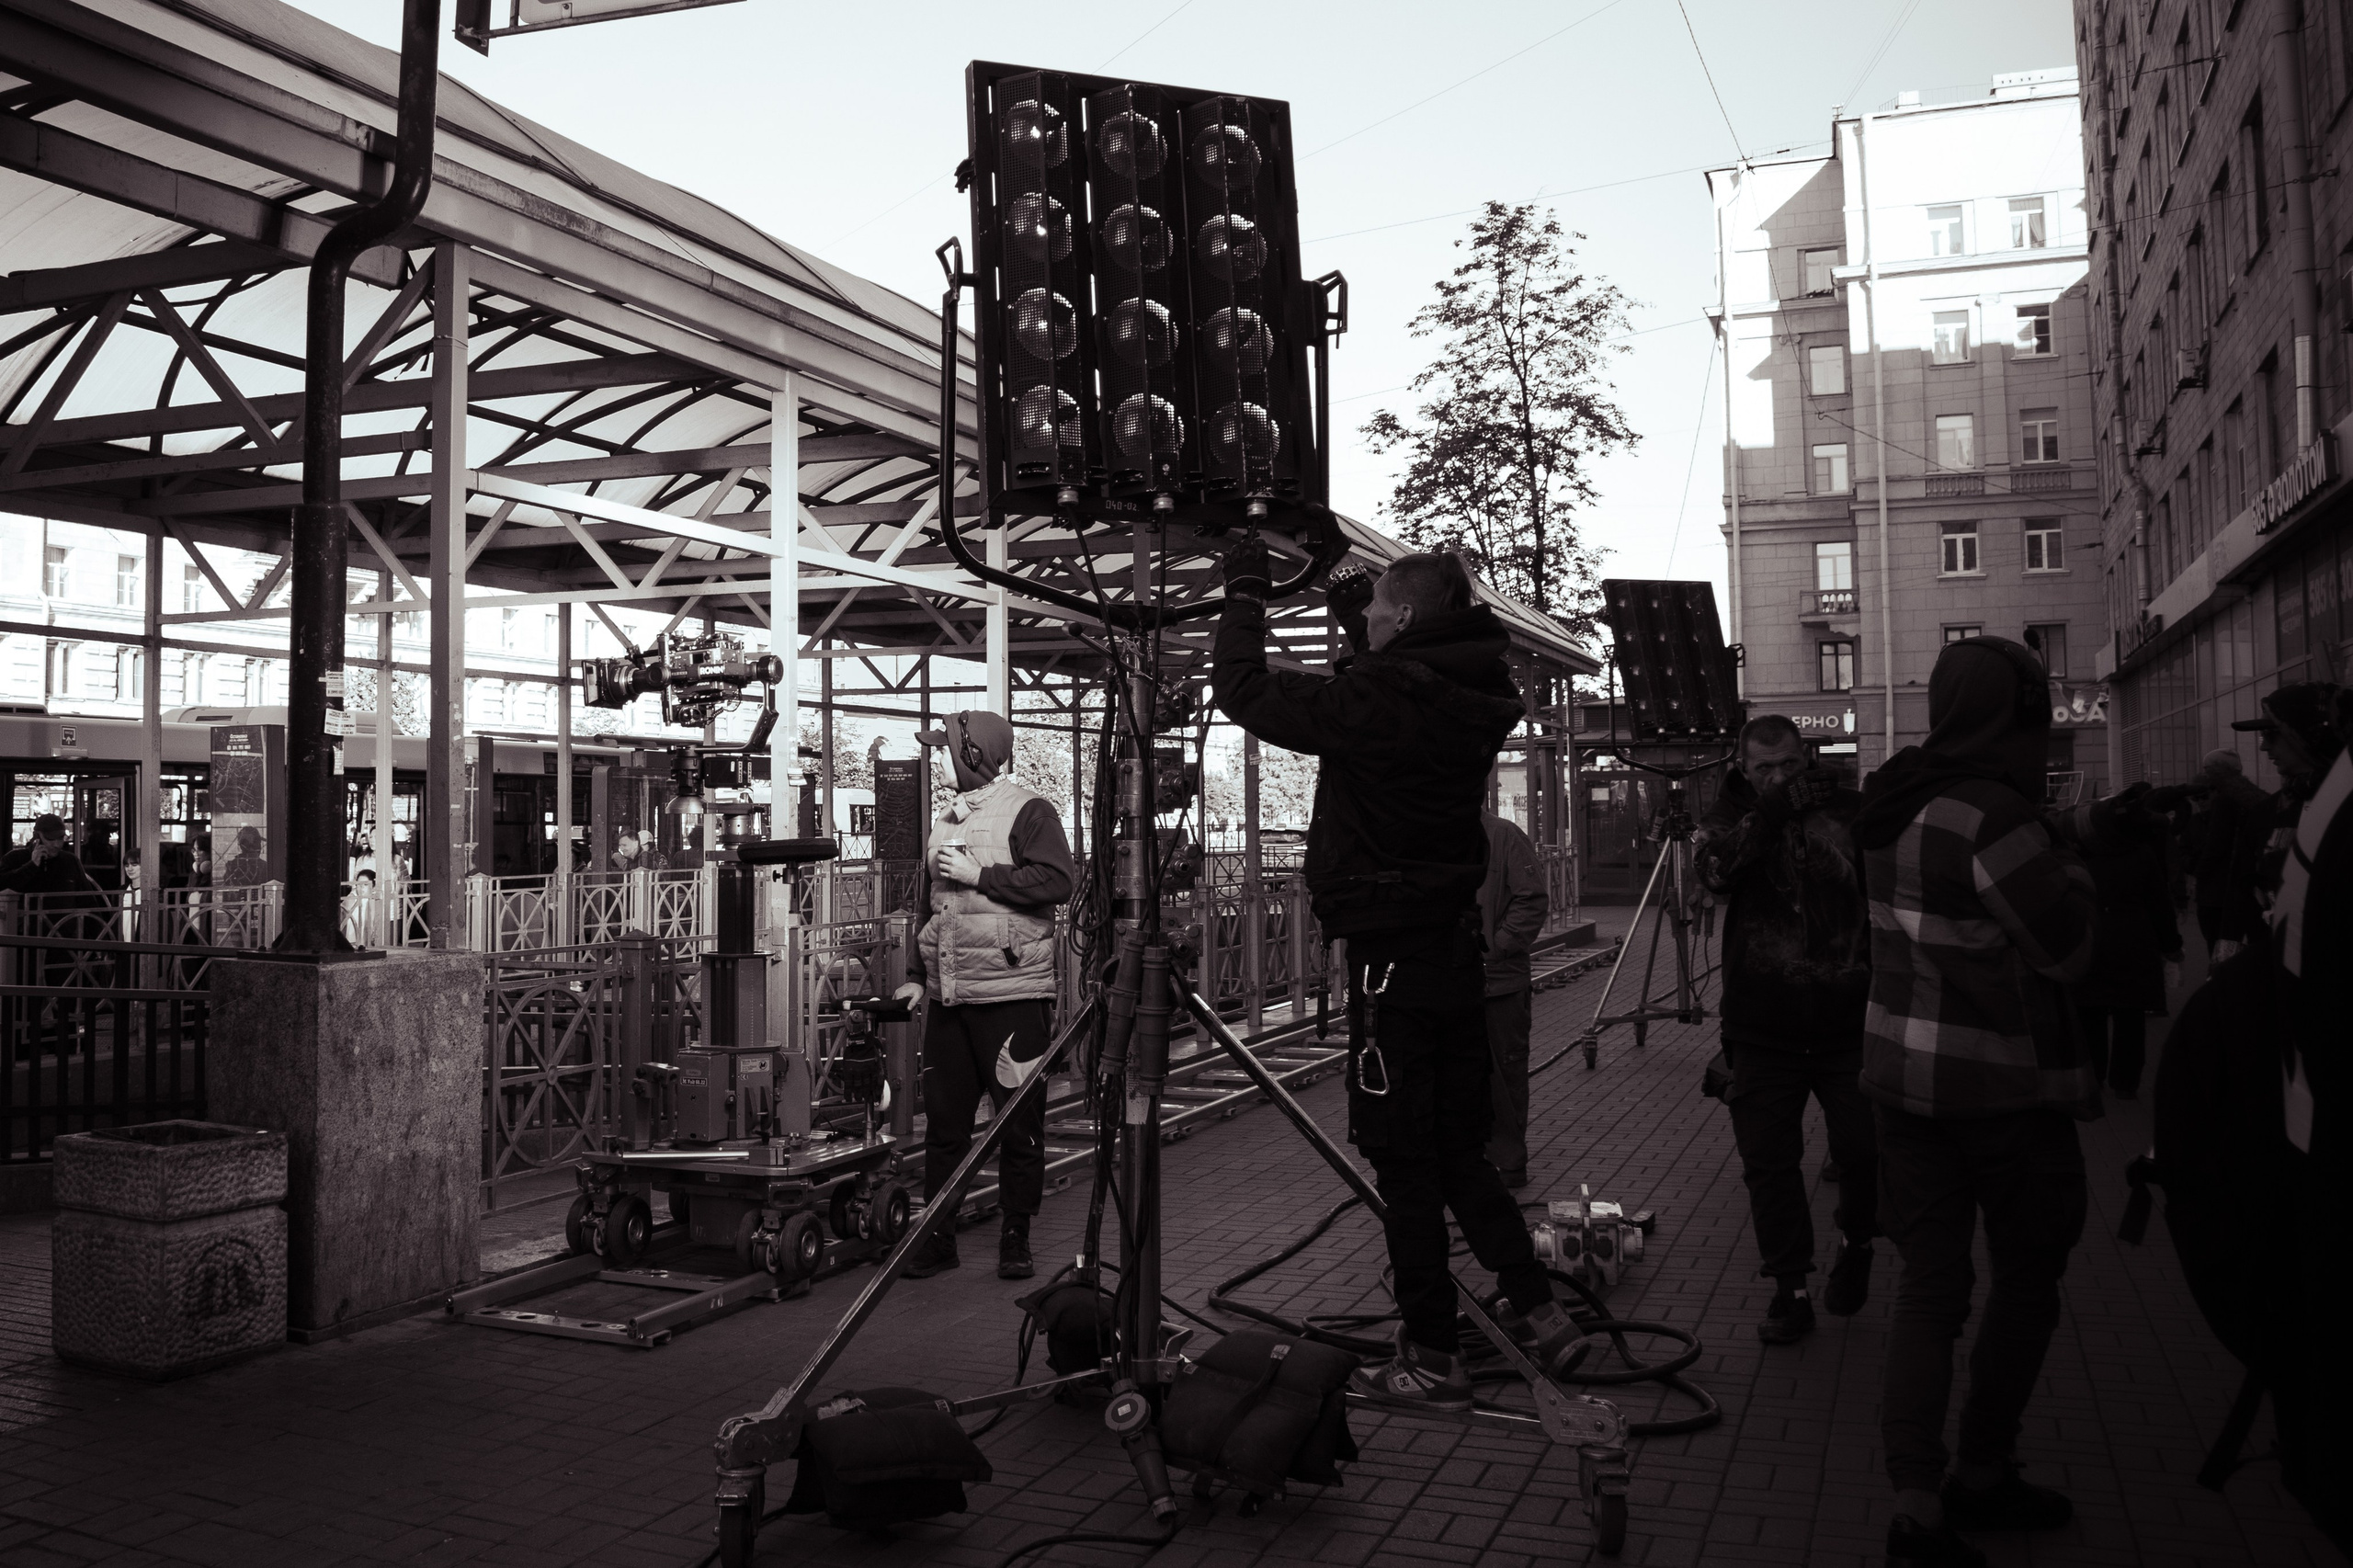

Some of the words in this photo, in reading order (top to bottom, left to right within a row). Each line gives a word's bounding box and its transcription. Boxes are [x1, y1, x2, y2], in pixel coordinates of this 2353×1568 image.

[2252, 491, 2267, 536] 585
[2275, 430, 2327, 517] ЗОЛОТОЙ
[2309, 574, 2326, 619] 585
[699, 665, 724, 676] RONIN
